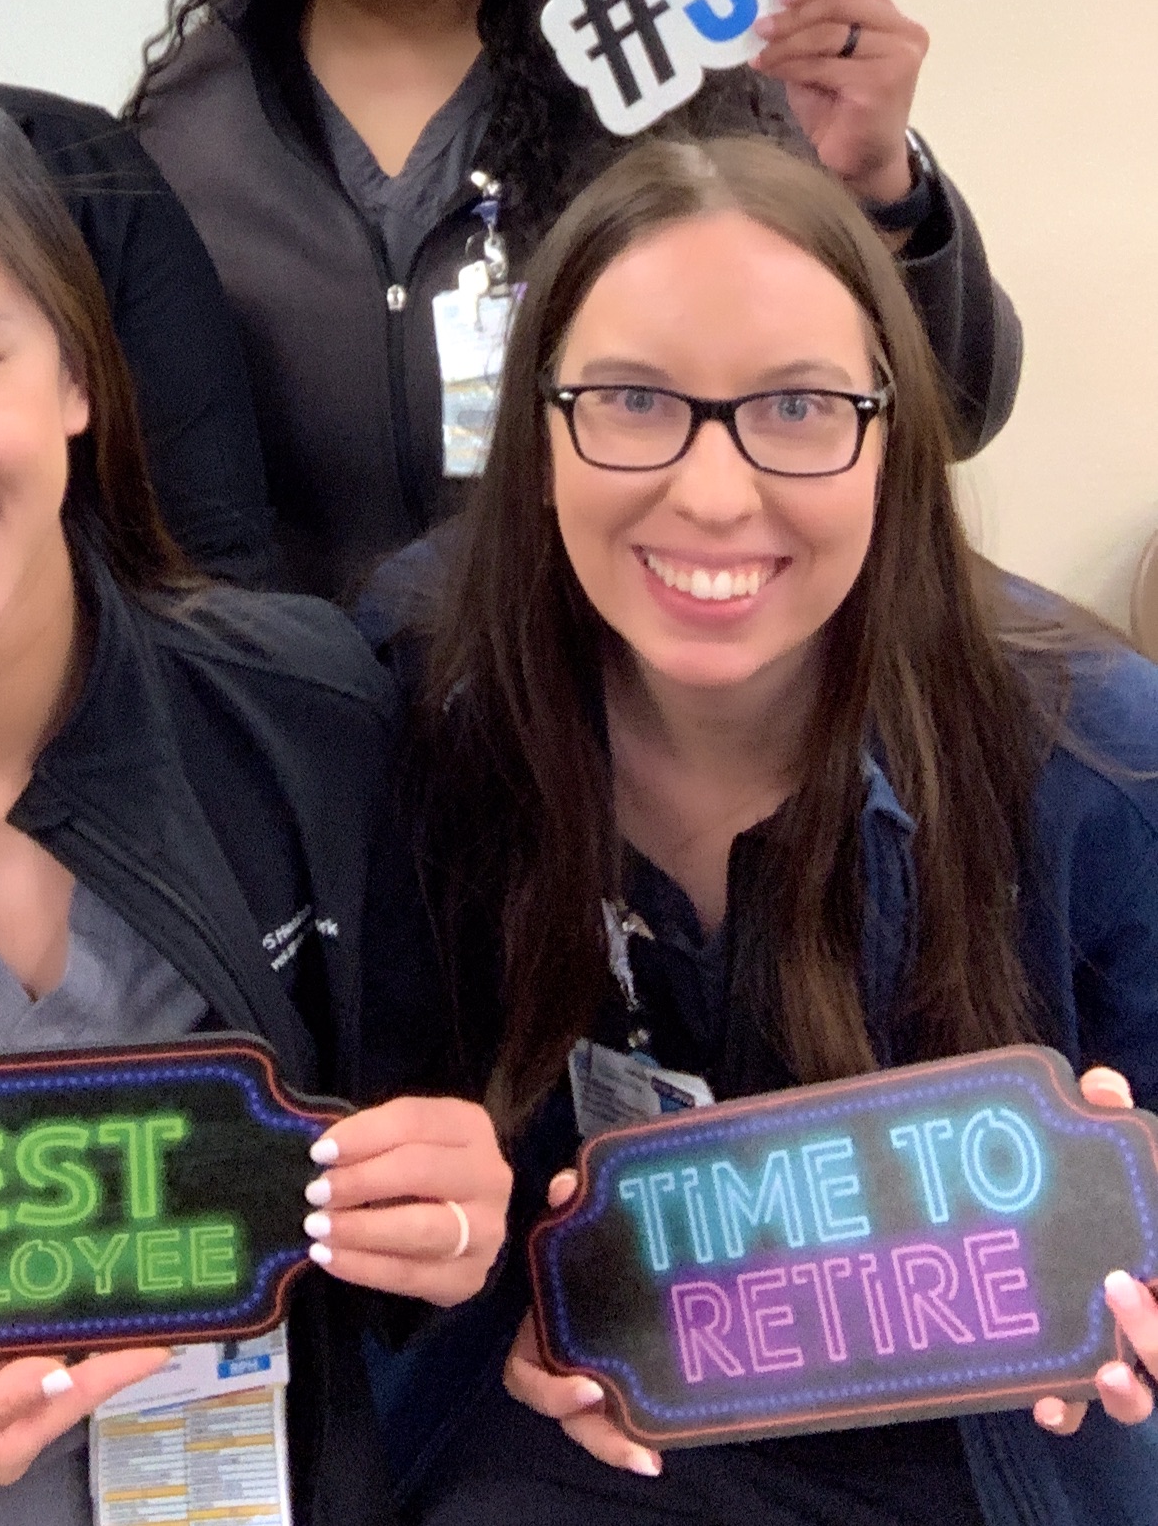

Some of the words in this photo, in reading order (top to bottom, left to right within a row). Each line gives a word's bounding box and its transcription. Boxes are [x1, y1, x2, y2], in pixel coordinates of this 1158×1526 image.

[619, 1136, 871, 1271] TIME
[891, 1107, 1043, 1224] TO
[671, 1229, 1040, 1383] RETIRE
